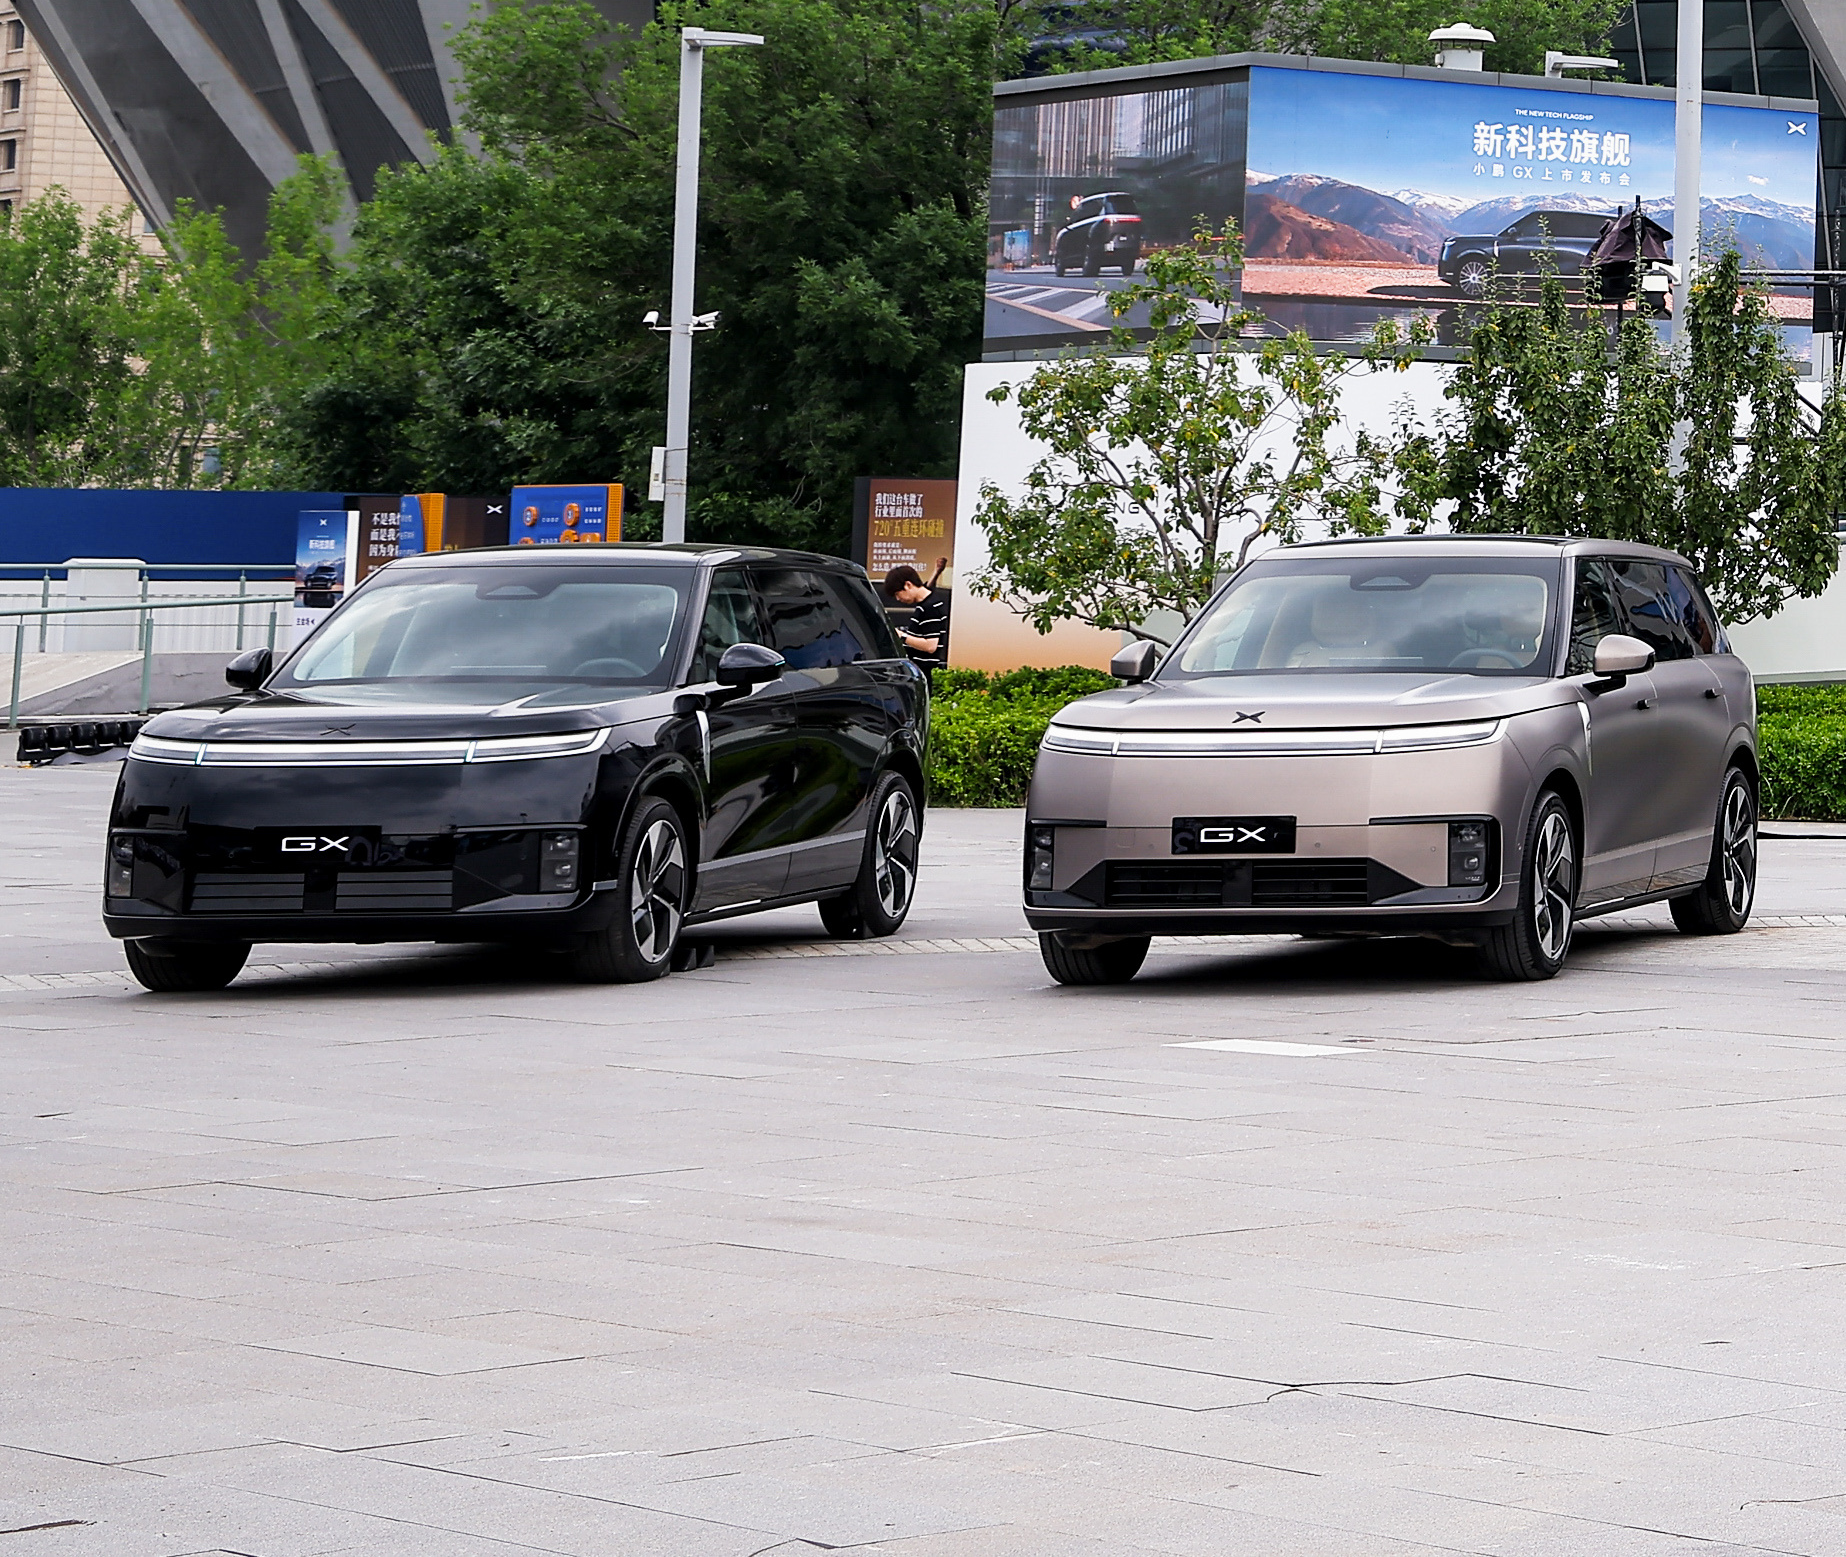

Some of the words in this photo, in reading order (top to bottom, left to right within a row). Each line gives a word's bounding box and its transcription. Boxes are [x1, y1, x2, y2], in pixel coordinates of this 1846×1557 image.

[1514, 108, 1528, 116] THE
[1545, 111, 1563, 119] TECH
[1563, 112, 1594, 121] FLAGSHIP
[1473, 121, 1632, 167] 新科技旗舰
[1200, 826, 1266, 843] GX
[281, 836, 350, 852] GX
